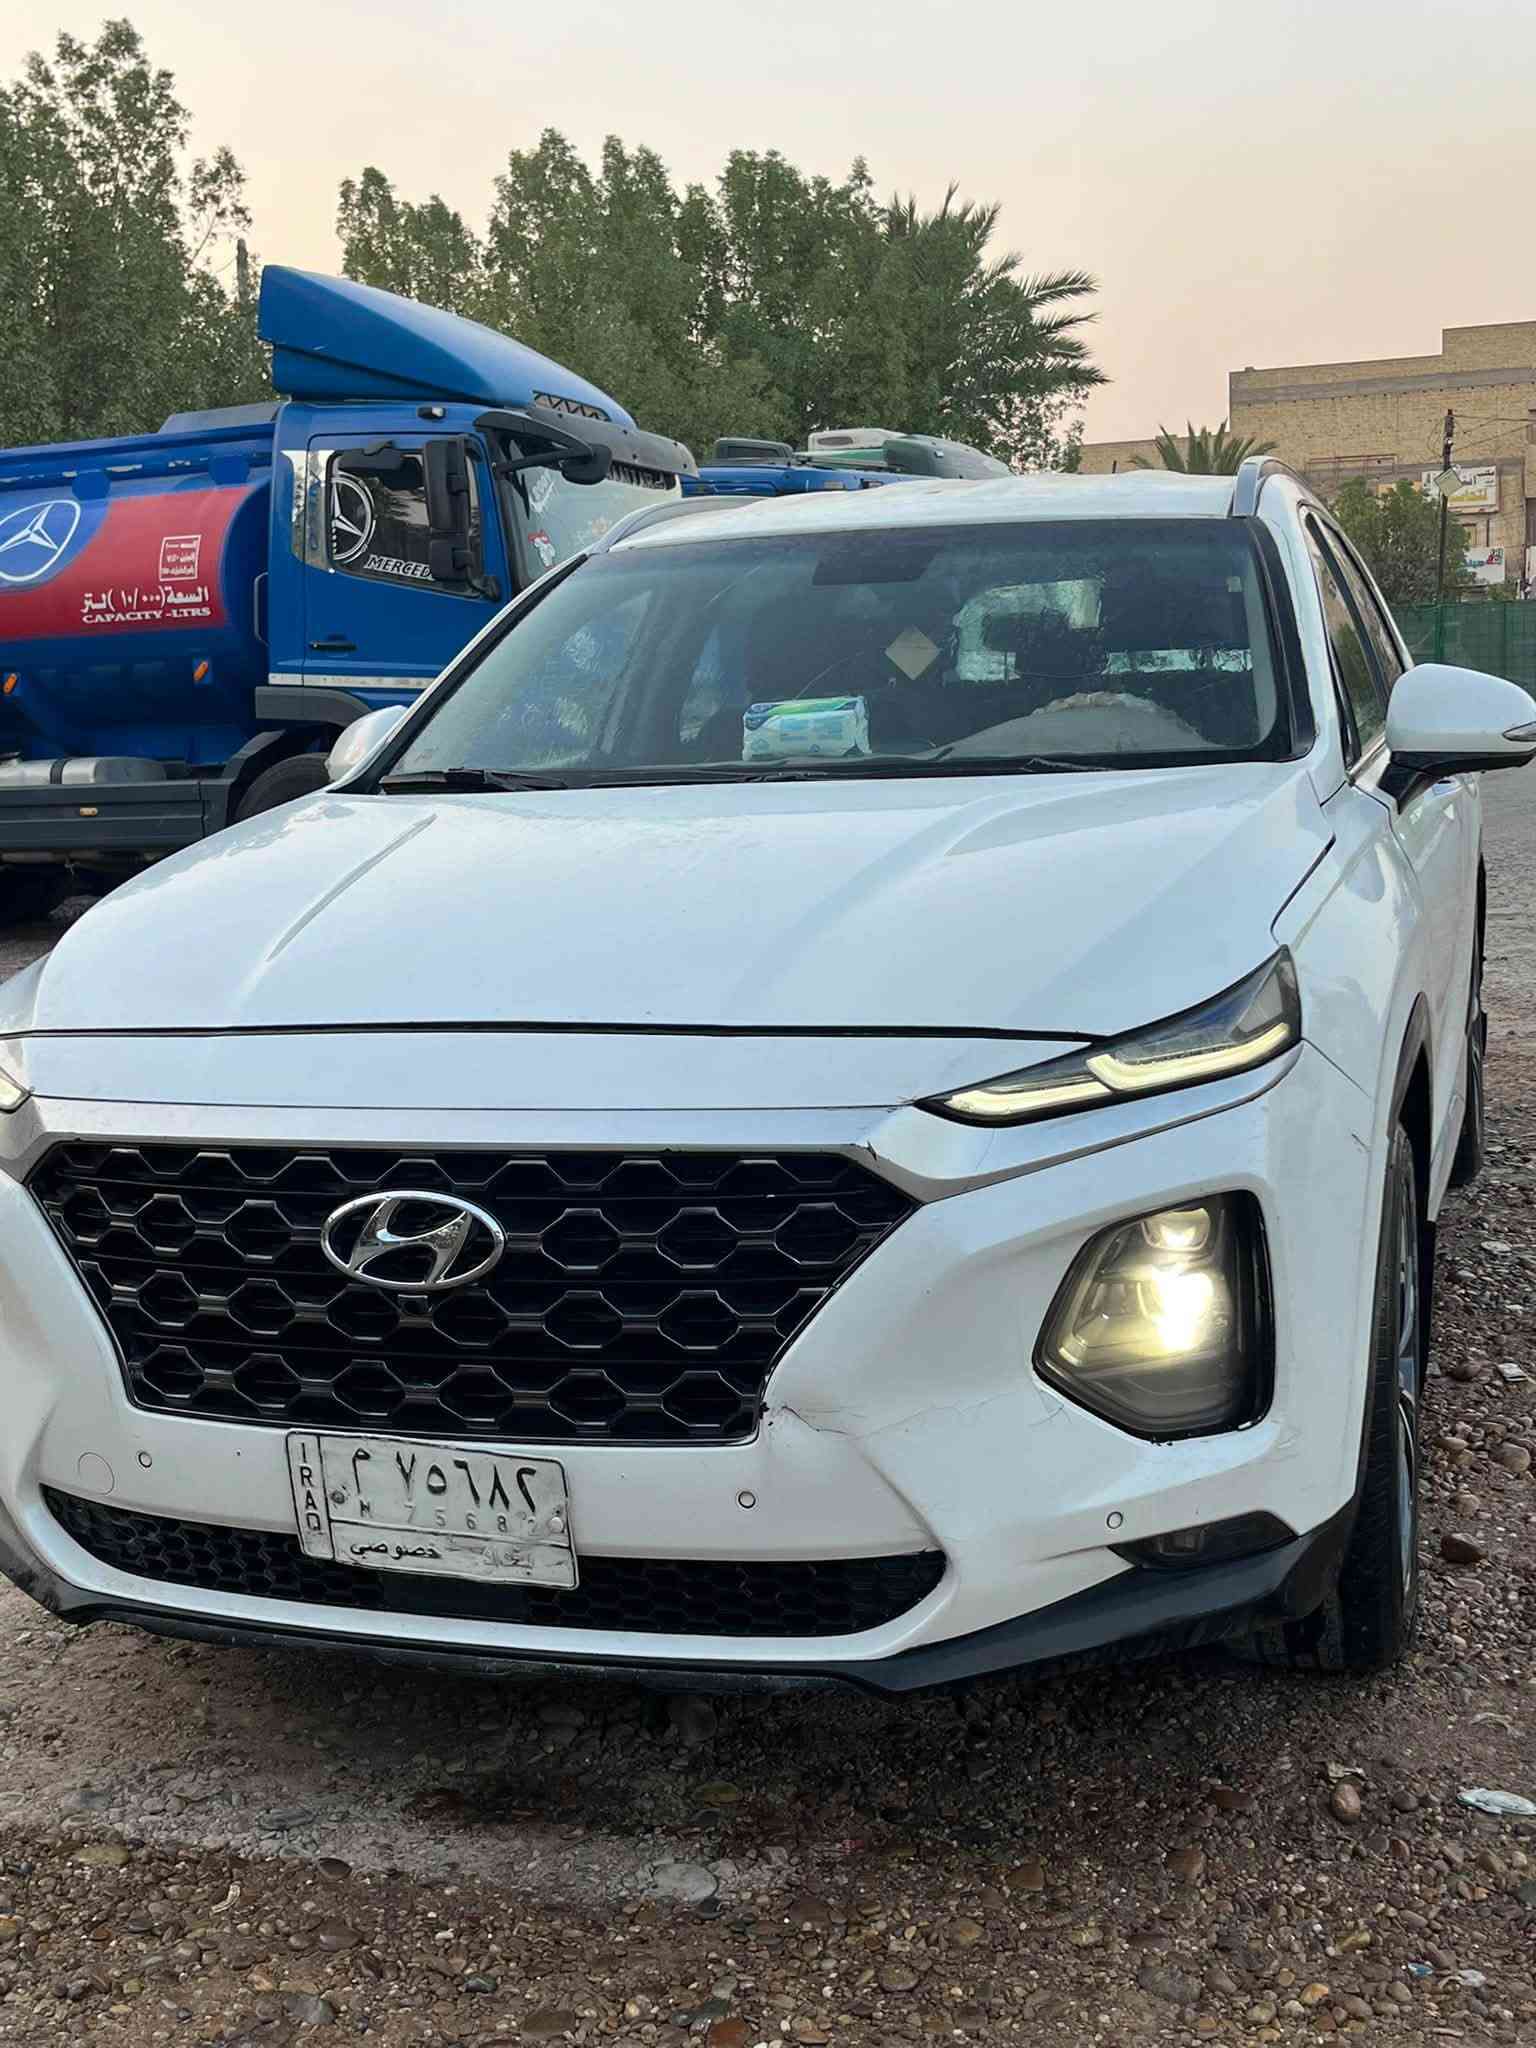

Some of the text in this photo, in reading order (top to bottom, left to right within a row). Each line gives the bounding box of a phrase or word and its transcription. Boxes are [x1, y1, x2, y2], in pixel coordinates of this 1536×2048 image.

[82, 609, 163, 624] CAPACITY
[298, 1441, 324, 1536] IRAQ
[395, 1450, 537, 1513] ٧٥٦٨٢
[404, 1502, 537, 1534] 75682
[349, 1540, 442, 1560] خصوصي
